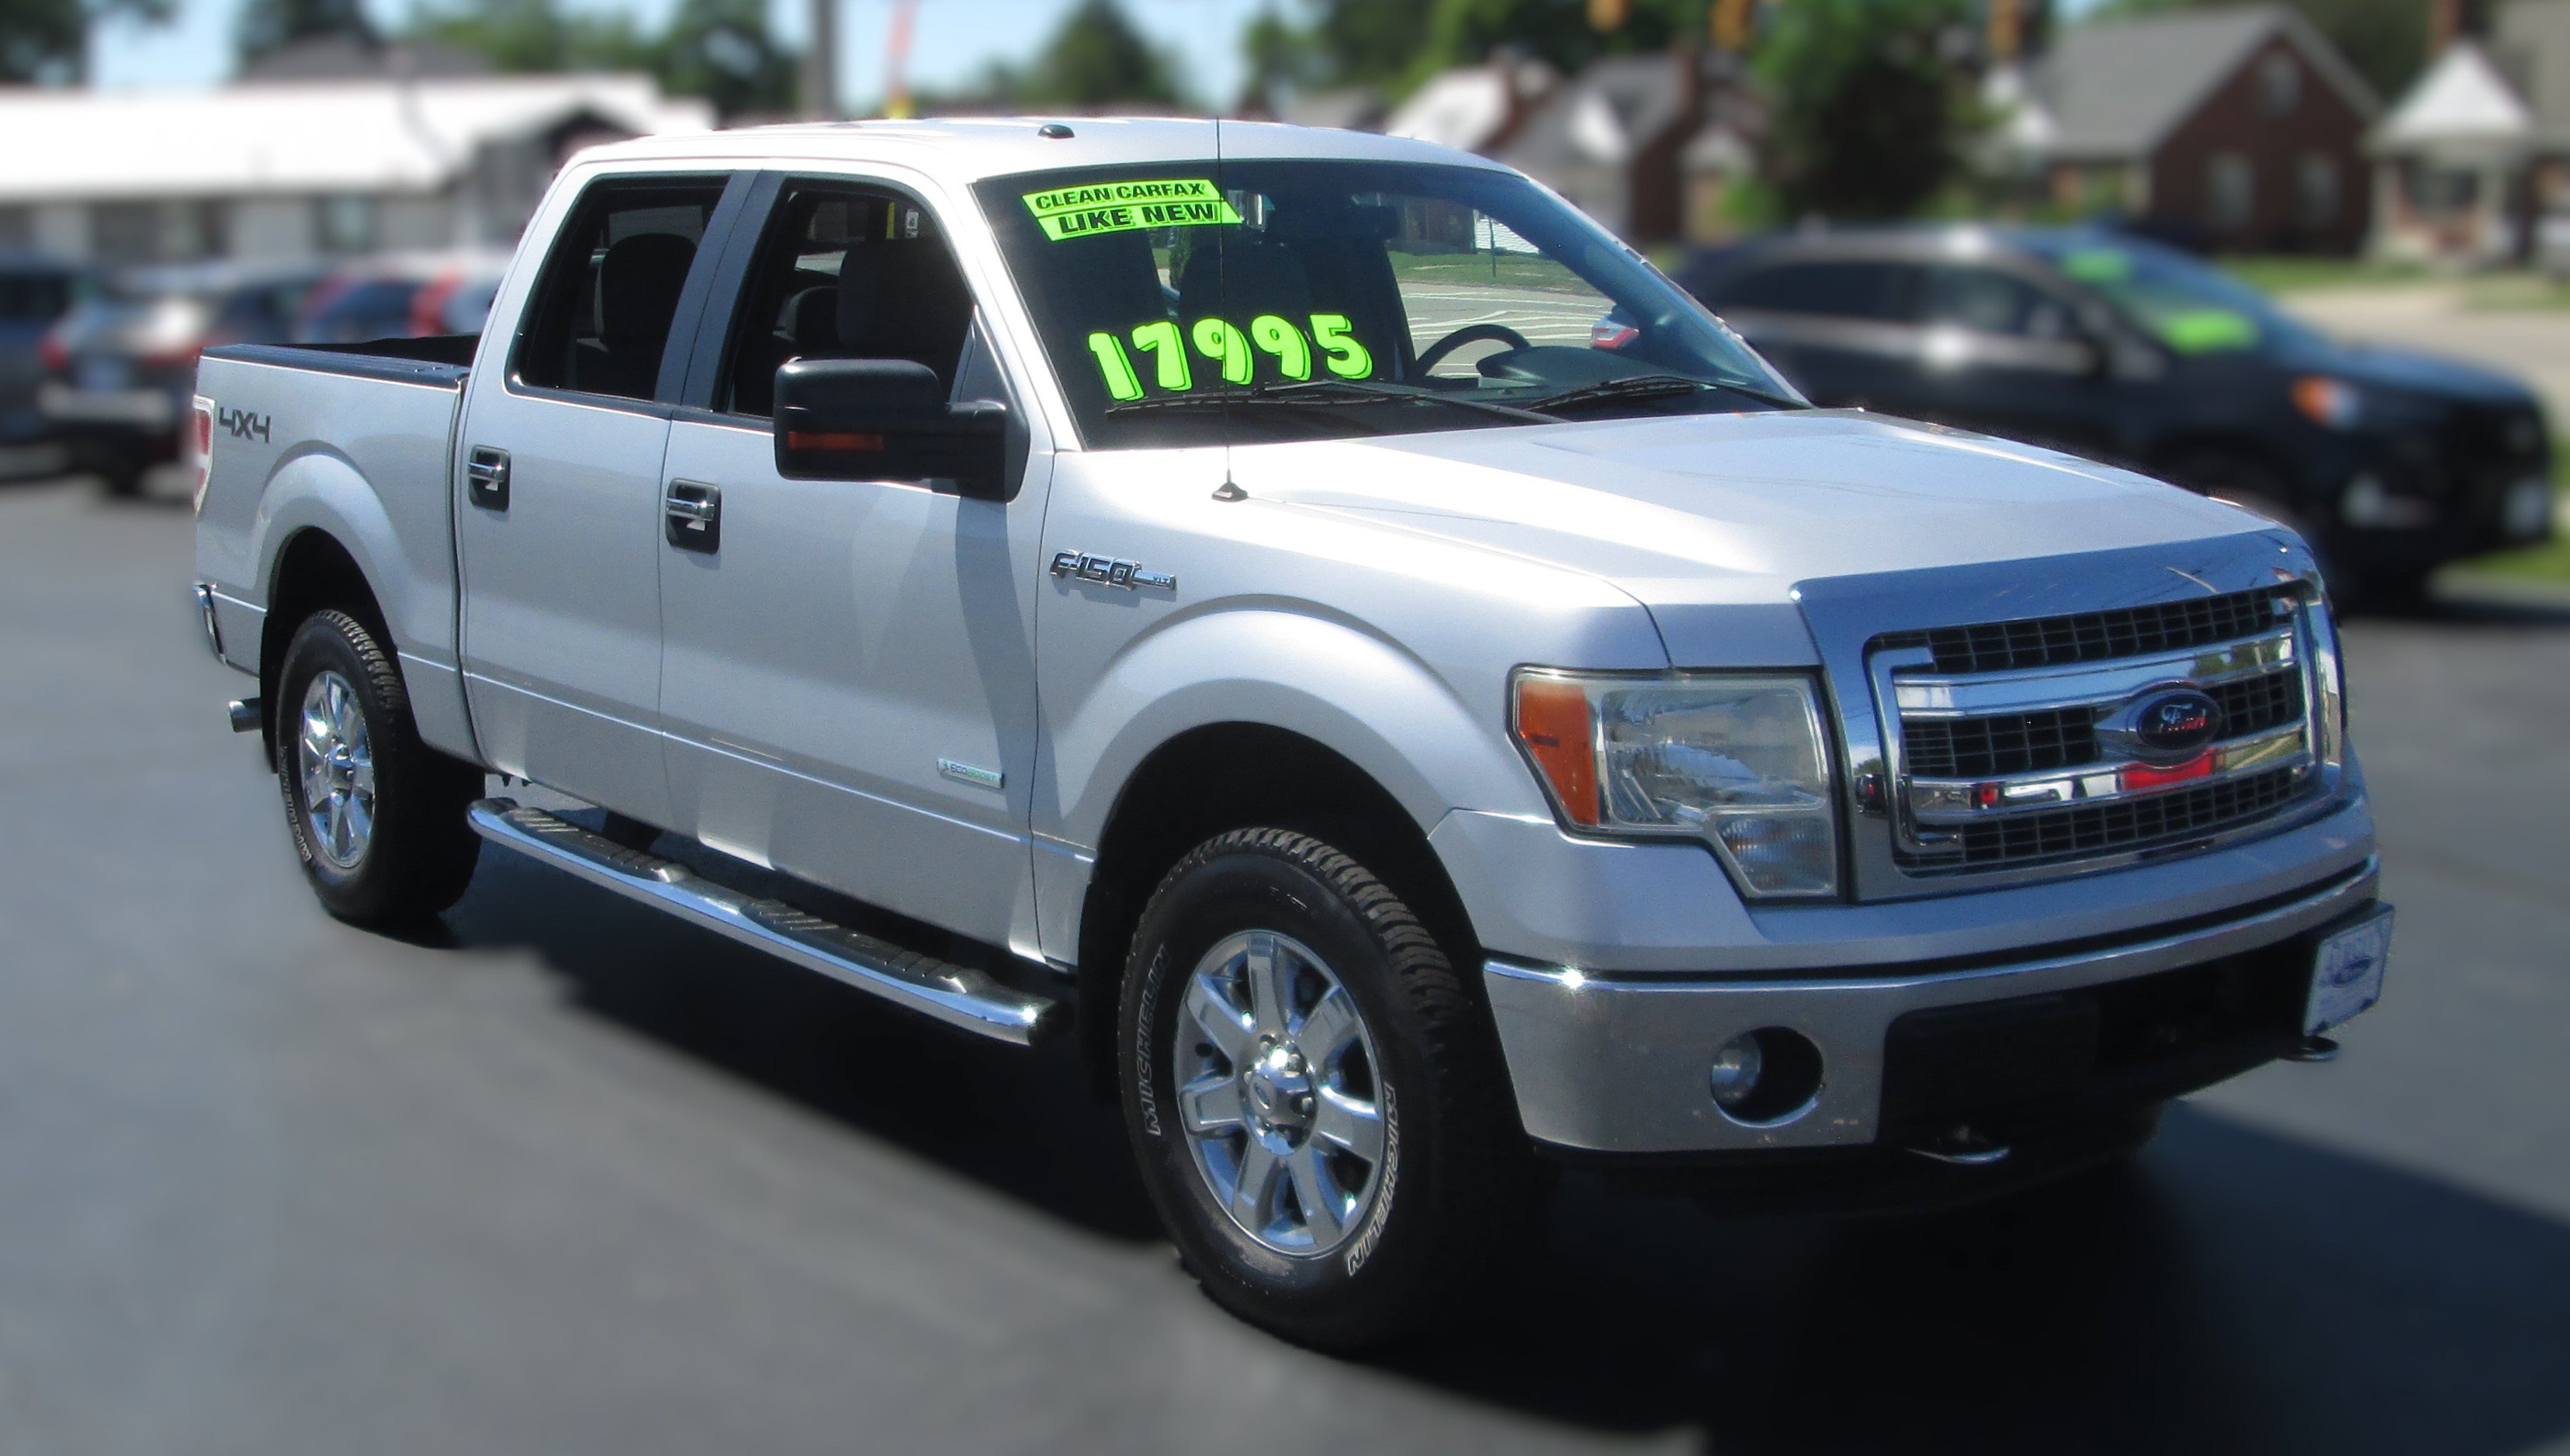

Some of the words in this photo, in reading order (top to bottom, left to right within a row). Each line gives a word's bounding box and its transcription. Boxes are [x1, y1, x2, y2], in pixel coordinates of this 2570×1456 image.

[1035, 188, 1113, 210] CLEAN
[1116, 182, 1207, 199] CARFAX
[1058, 208, 1133, 235] LIKE
[1141, 203, 1218, 224] NEW
[1088, 313, 1373, 400] 17995
[219, 406, 272, 444] 4X4
[1137, 942, 1167, 1136] MICHELIN
[1346, 1081, 1400, 1277] MICHELIN
